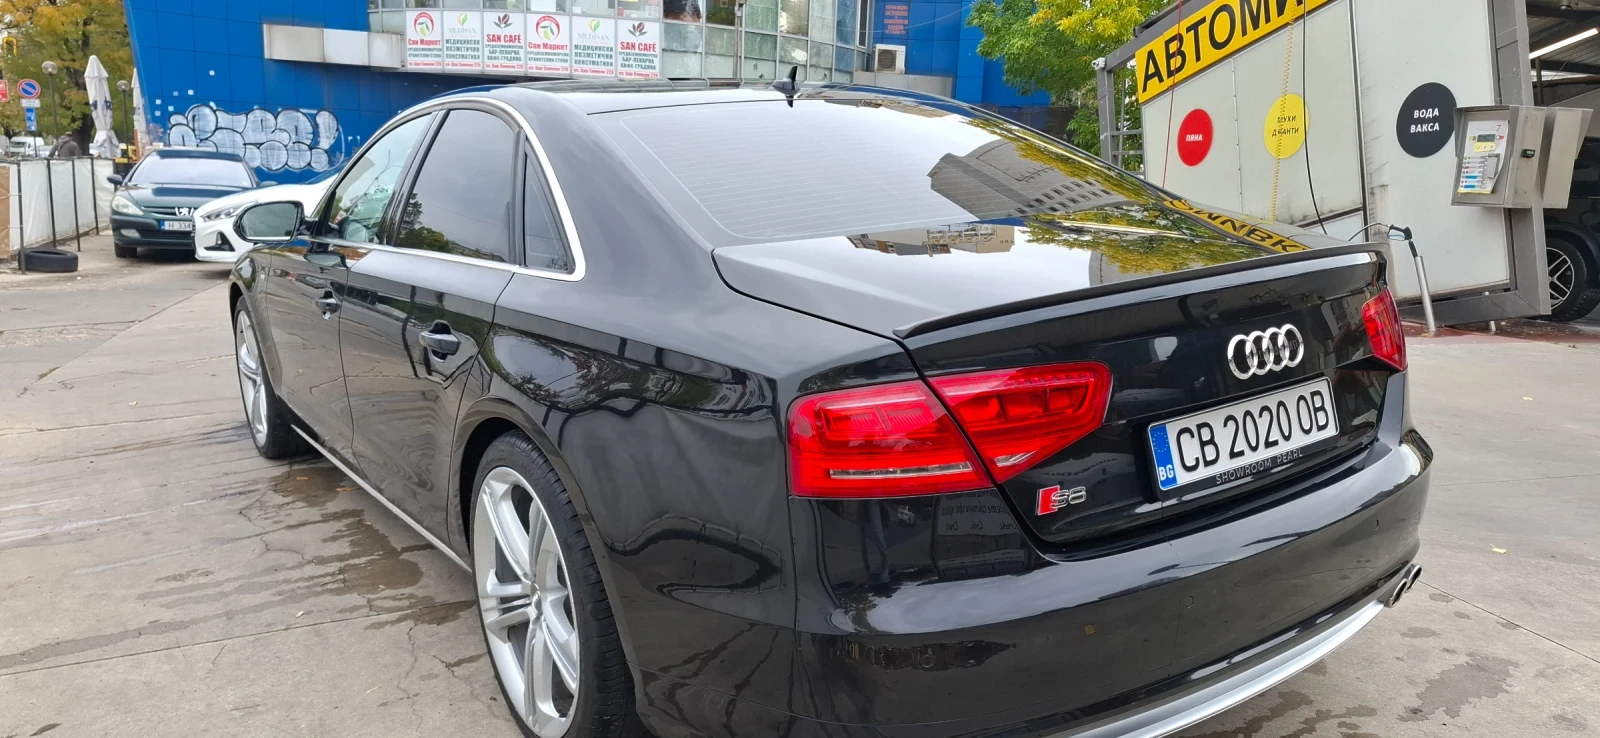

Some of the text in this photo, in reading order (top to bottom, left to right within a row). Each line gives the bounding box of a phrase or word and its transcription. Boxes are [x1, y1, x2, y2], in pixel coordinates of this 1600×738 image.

[408, 38, 441, 46] Сан Маркет
[486, 33, 522, 44] SAN CAFÉ
[528, 42, 568, 50] Сан Маркет
[574, 44, 614, 52] МЕДИЦИНСКИ
[620, 41, 636, 51] SAN
[637, 41, 657, 53] CAFÉ
[574, 52, 613, 60] КОЗМЕТИЧНИ
[574, 59, 614, 67] КОНСУМАТИВИ
[1413, 107, 1439, 119] ВОДА
[1410, 122, 1440, 134] ВАКСА
[1185, 133, 1203, 142] ПЯНА
[1175, 421, 1221, 473] CB
[1223, 400, 1292, 460] 2020
[1296, 389, 1330, 435] OB
[1215, 448, 1303, 485] SHOWROOM PEARL
[1158, 465, 1175, 481] BG
[1049, 486, 1087, 509] S8
